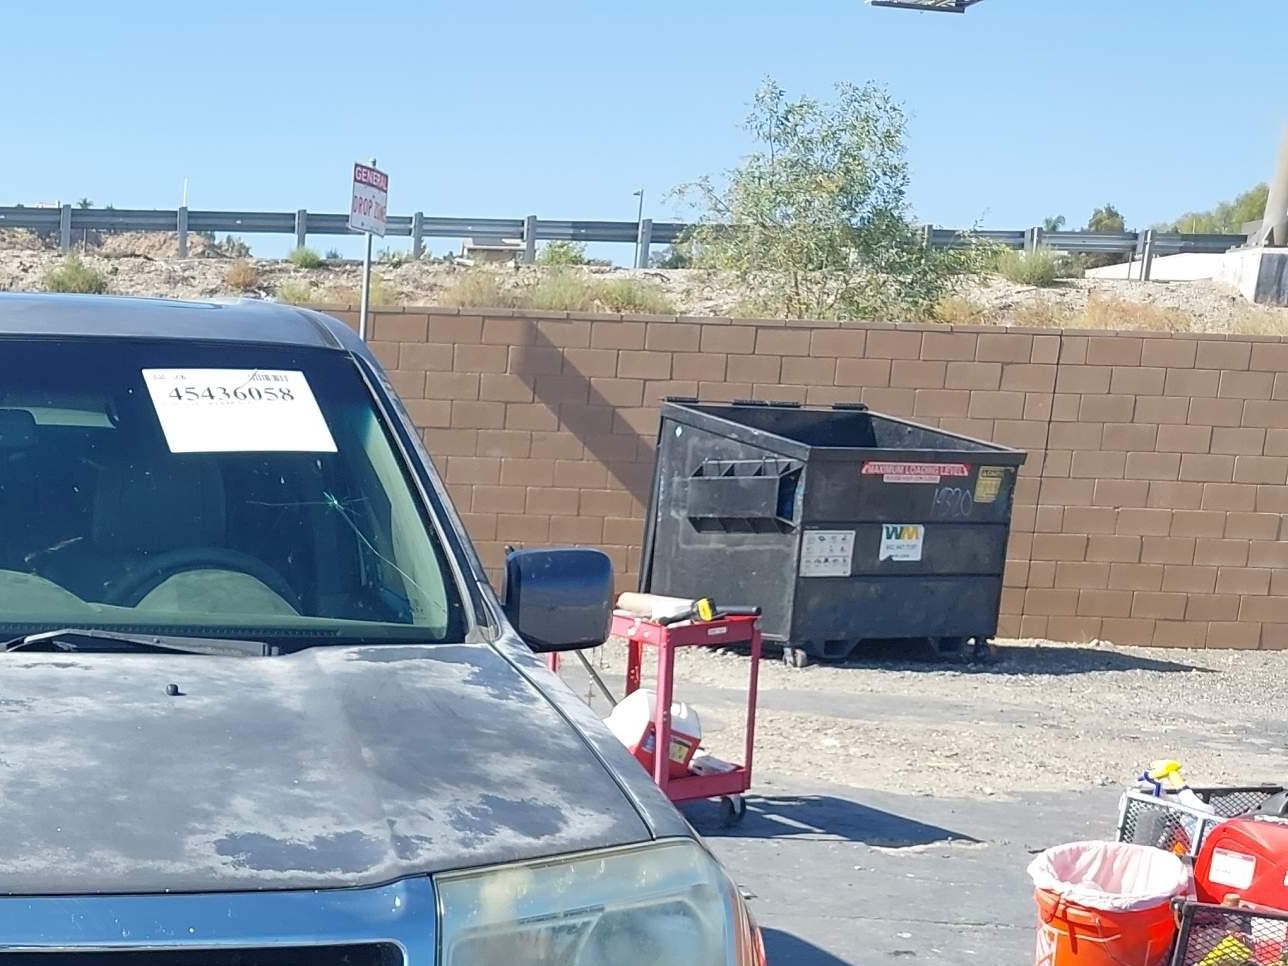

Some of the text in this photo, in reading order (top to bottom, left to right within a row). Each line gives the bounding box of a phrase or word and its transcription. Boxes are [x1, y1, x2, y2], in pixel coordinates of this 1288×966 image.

[168, 386, 295, 401] 45436058
[865, 464, 965, 476] MAXIMUM LOADING LEVEL
[885, 526, 920, 540] WM
